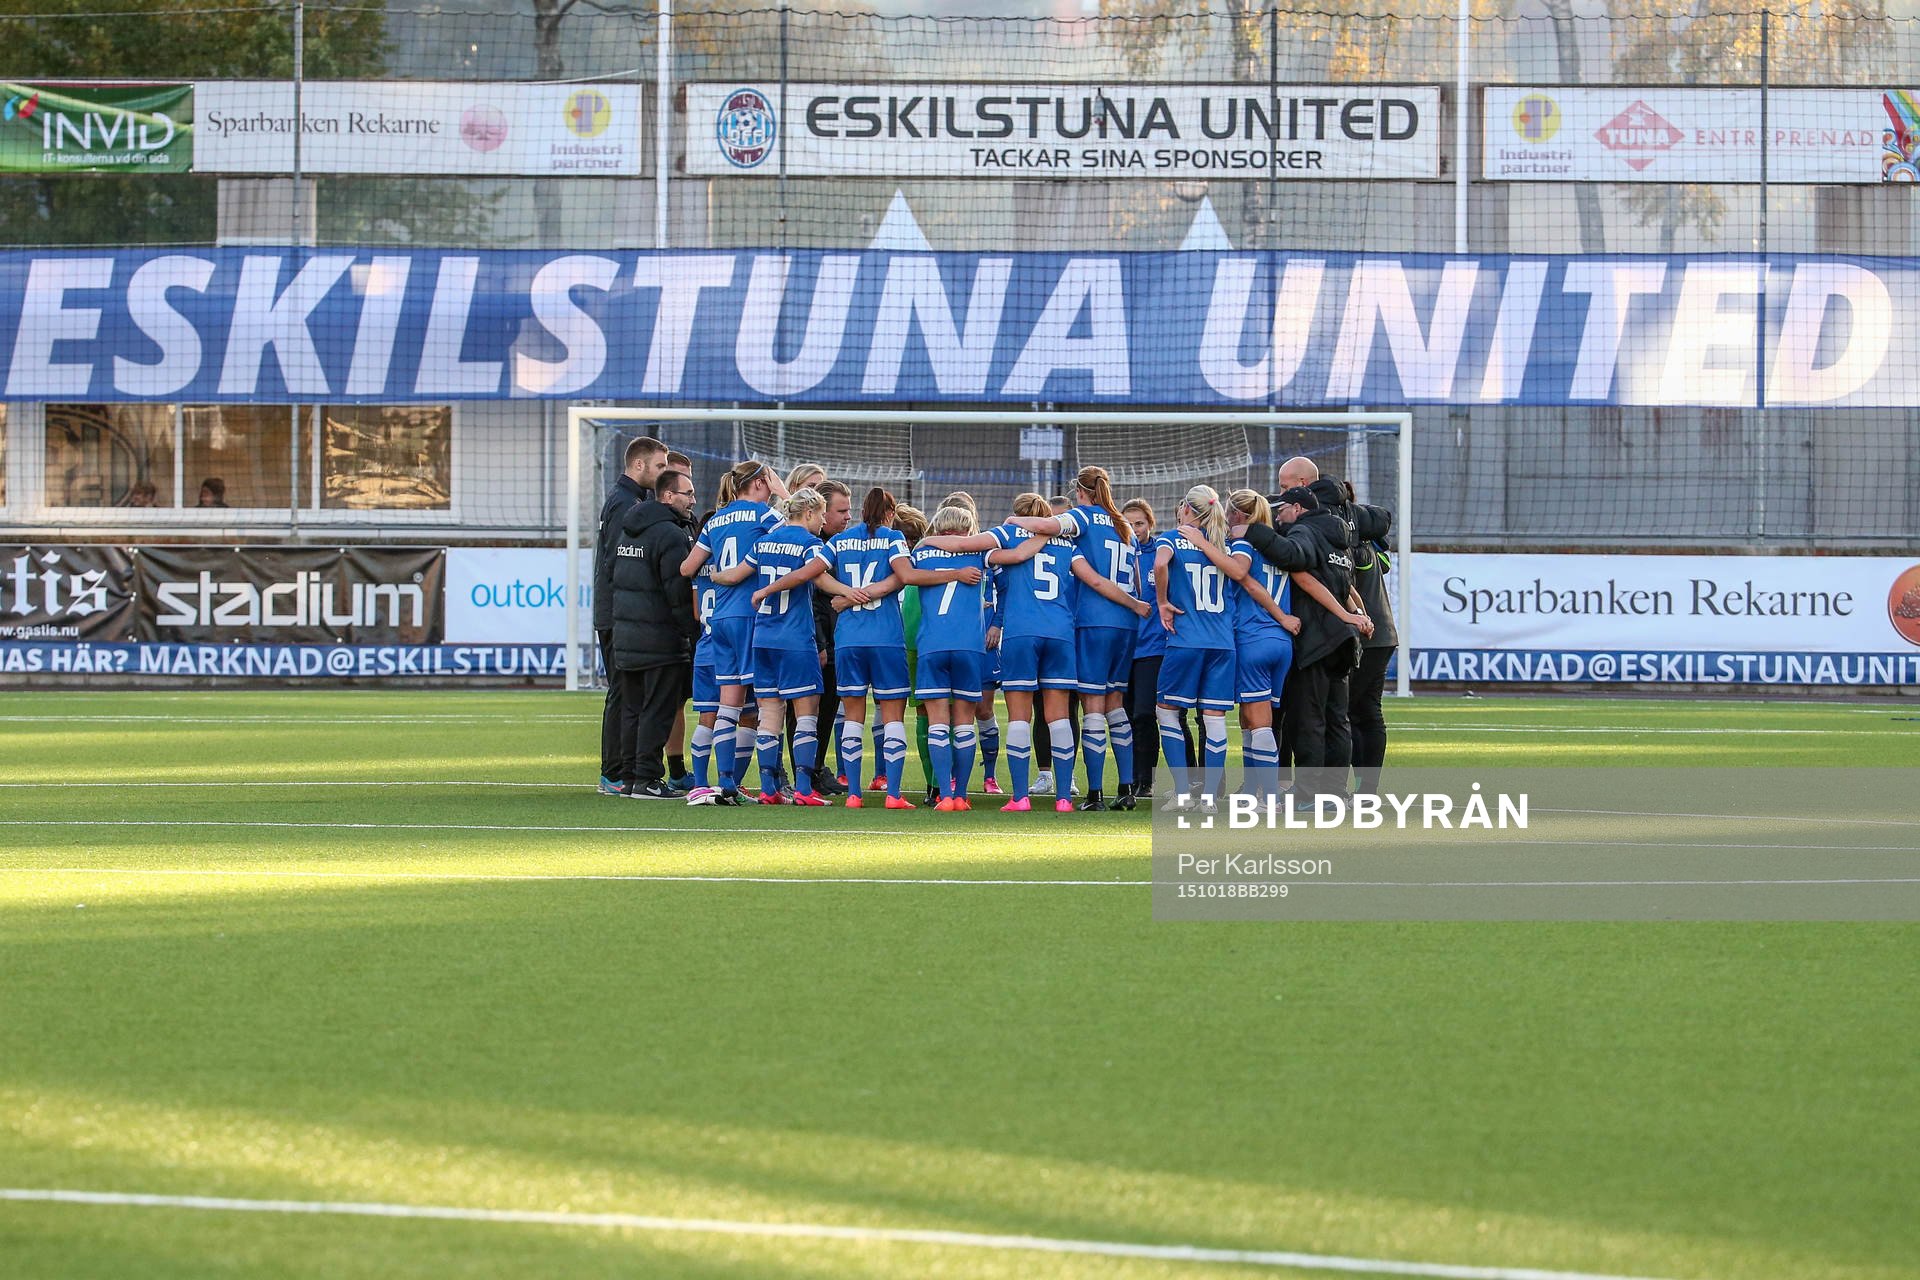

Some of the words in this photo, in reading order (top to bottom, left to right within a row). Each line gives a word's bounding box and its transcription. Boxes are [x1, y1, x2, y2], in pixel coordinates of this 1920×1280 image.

[43, 112, 174, 150] INVID
[349, 112, 440, 134] Rekarne
[806, 96, 1181, 139] ESKILSTUNA
[1201, 97, 1418, 140] UNITED
[551, 144, 623, 155] Industri
[553, 158, 622, 170] partner
[970, 148, 1070, 168] TACKAR
[1082, 149, 1145, 169] SINA
[1155, 149, 1322, 169] SPONSORER
[1500, 148, 1572, 160] Industri
[1501, 164, 1571, 175] partner
[4, 255, 1132, 398] ESKILSTUNA
[1199, 258, 1893, 405] UNITED
[708, 511, 756, 531] ESKILSTUNA
[720, 536, 738, 573] 4
[836, 538, 890, 551] ESKILSTUNA
[0, 550, 108, 617] tis
[1034, 553, 1059, 600] 5
[1104, 539, 1136, 593] 15
[155, 570, 424, 627] stadium
[1184, 562, 1225, 614] 10
[1442, 576, 1674, 624] Sparbanken
[1689, 579, 1853, 617] Rekarne
[51, 643, 129, 672] HÄR?
